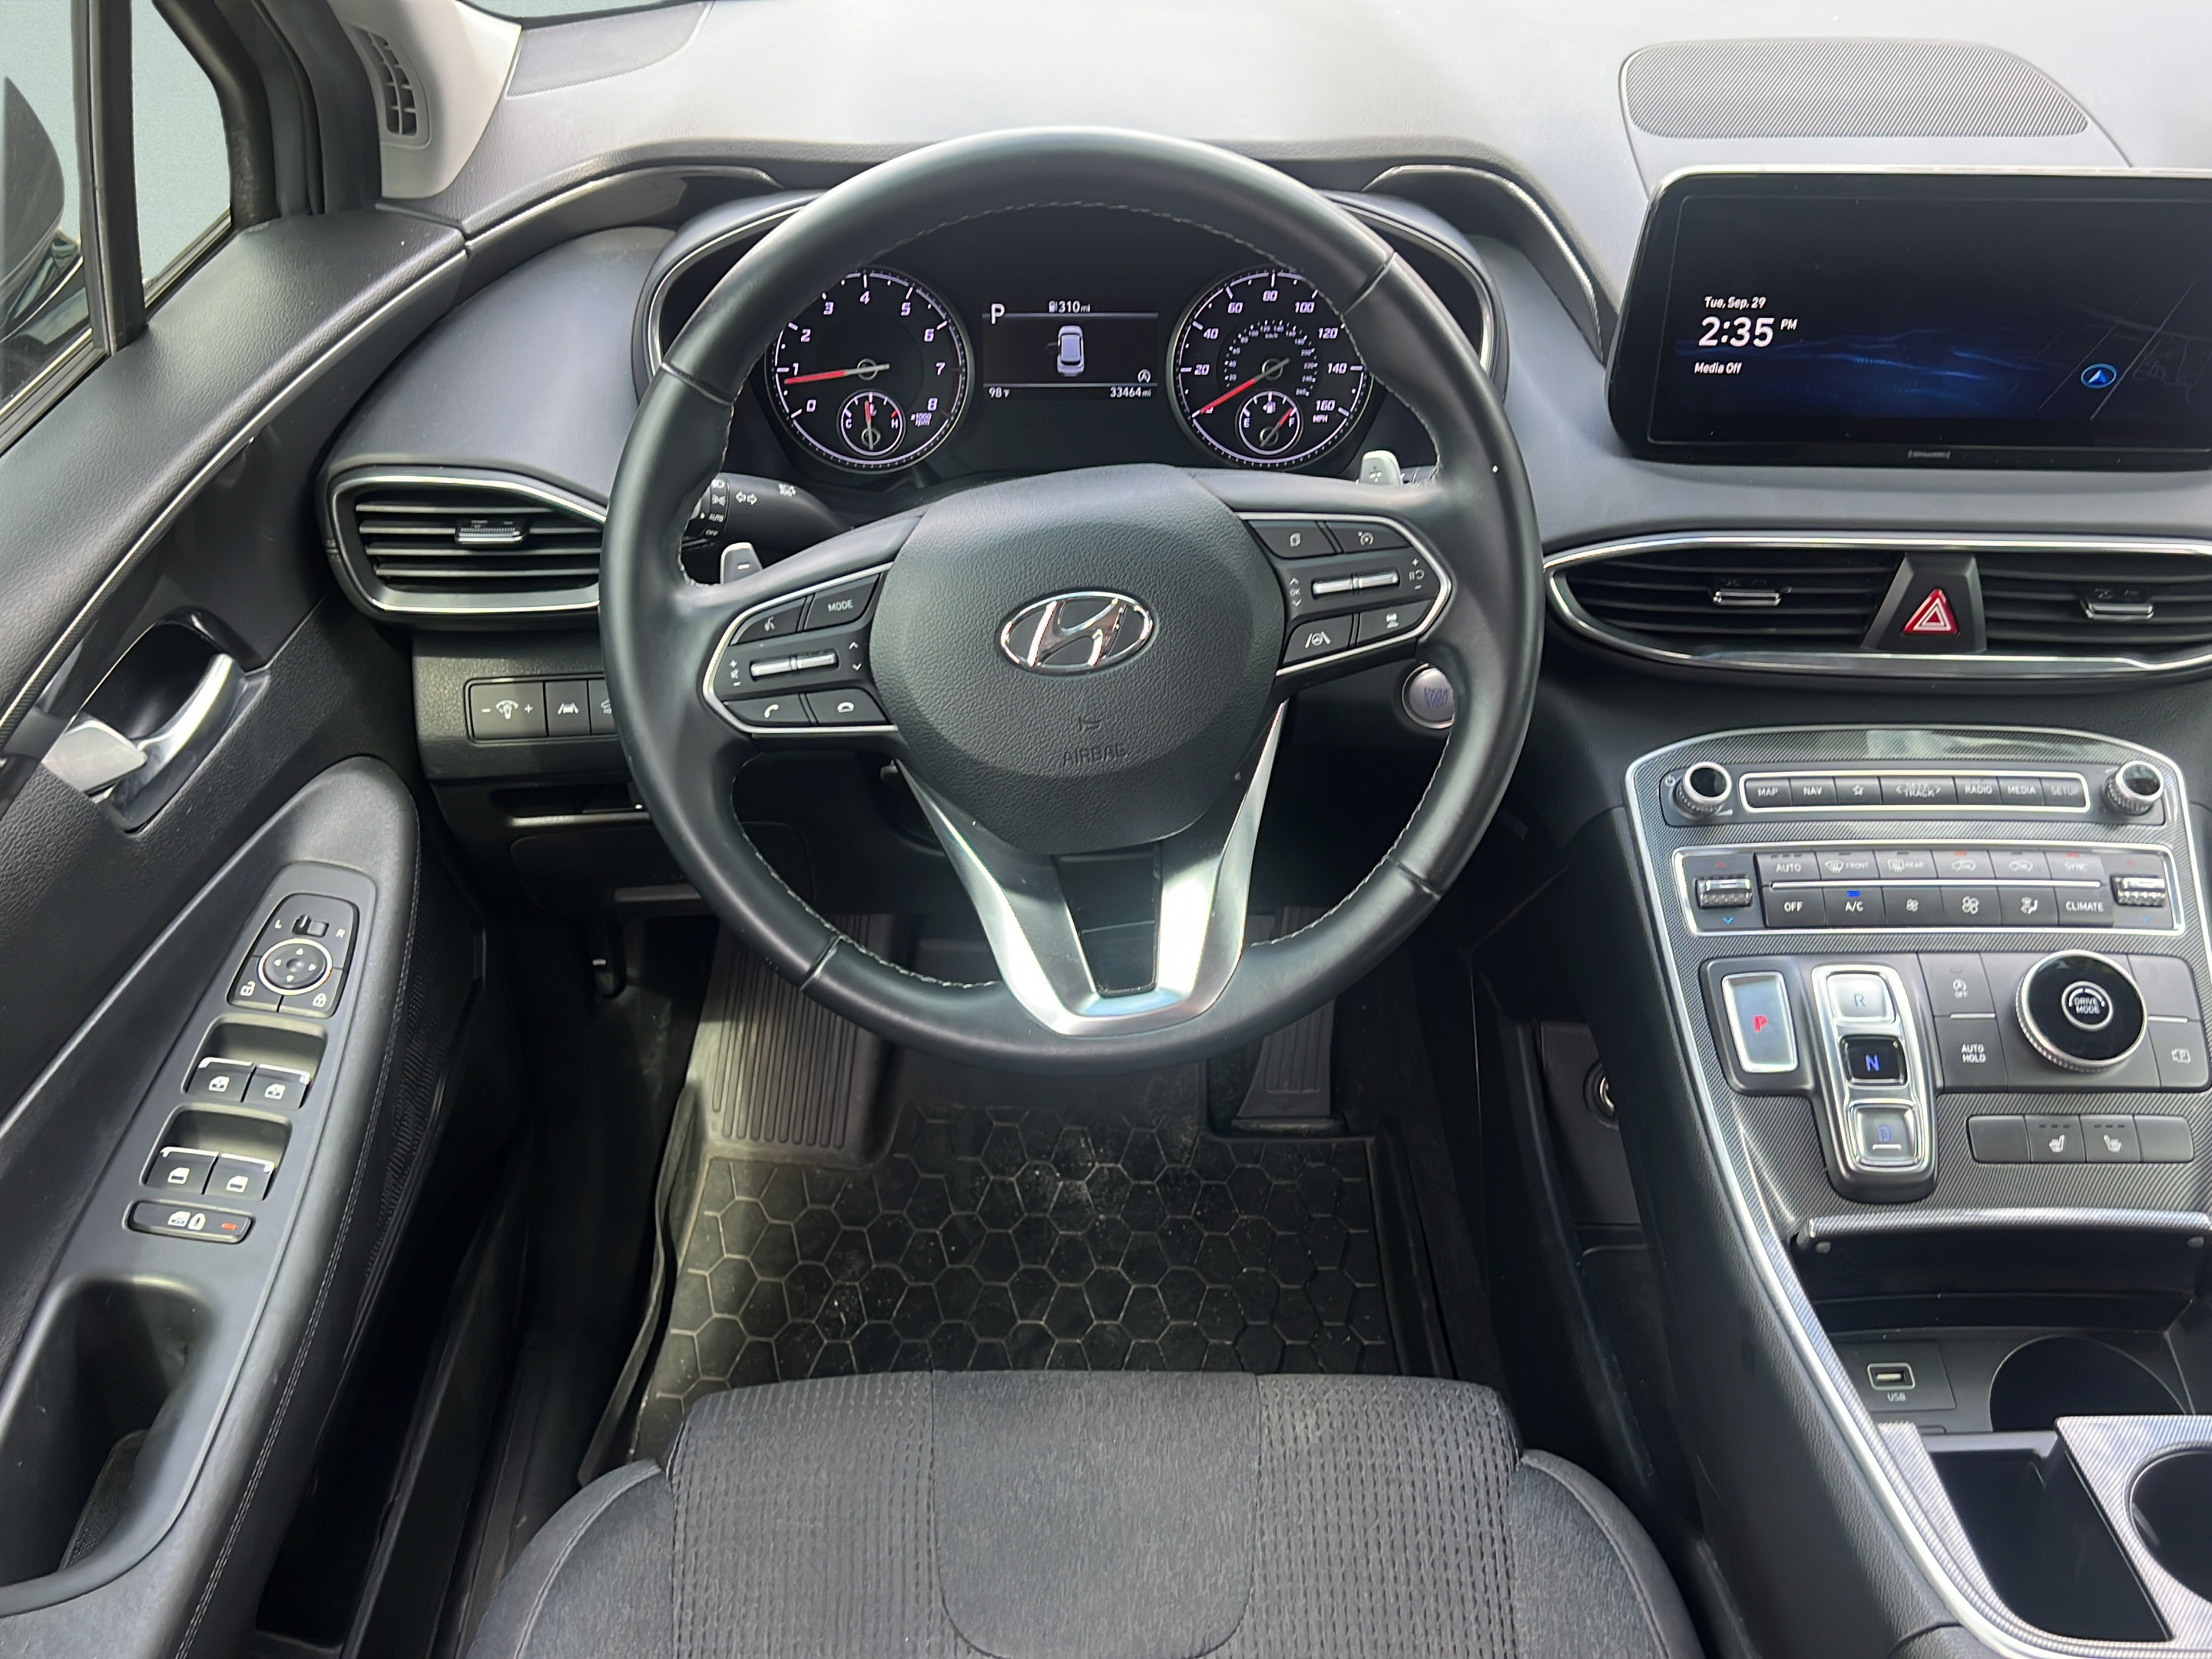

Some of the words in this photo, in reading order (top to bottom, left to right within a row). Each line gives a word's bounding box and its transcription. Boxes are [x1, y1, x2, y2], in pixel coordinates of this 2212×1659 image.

[859, 291, 870, 305] 4
[1750, 296, 1767, 309] 29
[823, 302, 834, 315] 3
[900, 302, 912, 316] 5
[1294, 302, 1315, 313] 100
[991, 303, 1005, 324] P
[800, 329, 811, 342] 2
[923, 328, 935, 342] 6
[1203, 328, 1219, 339] 40
[1318, 328, 1338, 339] 120
[1698, 316, 1775, 347] 2:35
[1780, 319, 1798, 330] PM
[792, 363, 800, 376] 1
[935, 363, 945, 376] 7
[1194, 364, 1210, 375] 20
[1327, 363, 1347, 374] 140
[1694, 363, 1724, 374] Media
[1726, 363, 1743, 375] Off
[806, 399, 816, 412] 0
[927, 397, 938, 411] 8
[845, 419, 853, 429] C
[891, 419, 899, 429] H
[1243, 418, 1250, 428] E
[1289, 417, 1295, 427] F
[708, 513, 724, 523] AUTO
[828, 599, 853, 612] MODE
[1757, 787, 1779, 797] MAP
[1803, 786, 1823, 796] NAV
[1965, 785, 1992, 795] RADIO
[2007, 785, 2036, 795] MEDIA
[2051, 785, 2080, 796] SETUP
[1776, 863, 1801, 873] AUTO
[1783, 901, 1803, 912] OFF
[1845, 901, 1864, 912] A/C
[2065, 901, 2104, 912] CLIMATE
[274, 919, 282, 929] L
[336, 929, 346, 938] R
[1853, 994, 1866, 1008] R
[2074, 997, 2098, 1006] DRIVE
[2076, 1005, 2101, 1015] MODE
[1753, 1015, 1767, 1032] P
[1961, 1044, 1984, 1053] AUTO
[1865, 1055, 1881, 1071] N
[1962, 1053, 1986, 1063] HOLD
[1876, 1125, 1892, 1143] D
[1887, 1392, 1906, 1402] USB
